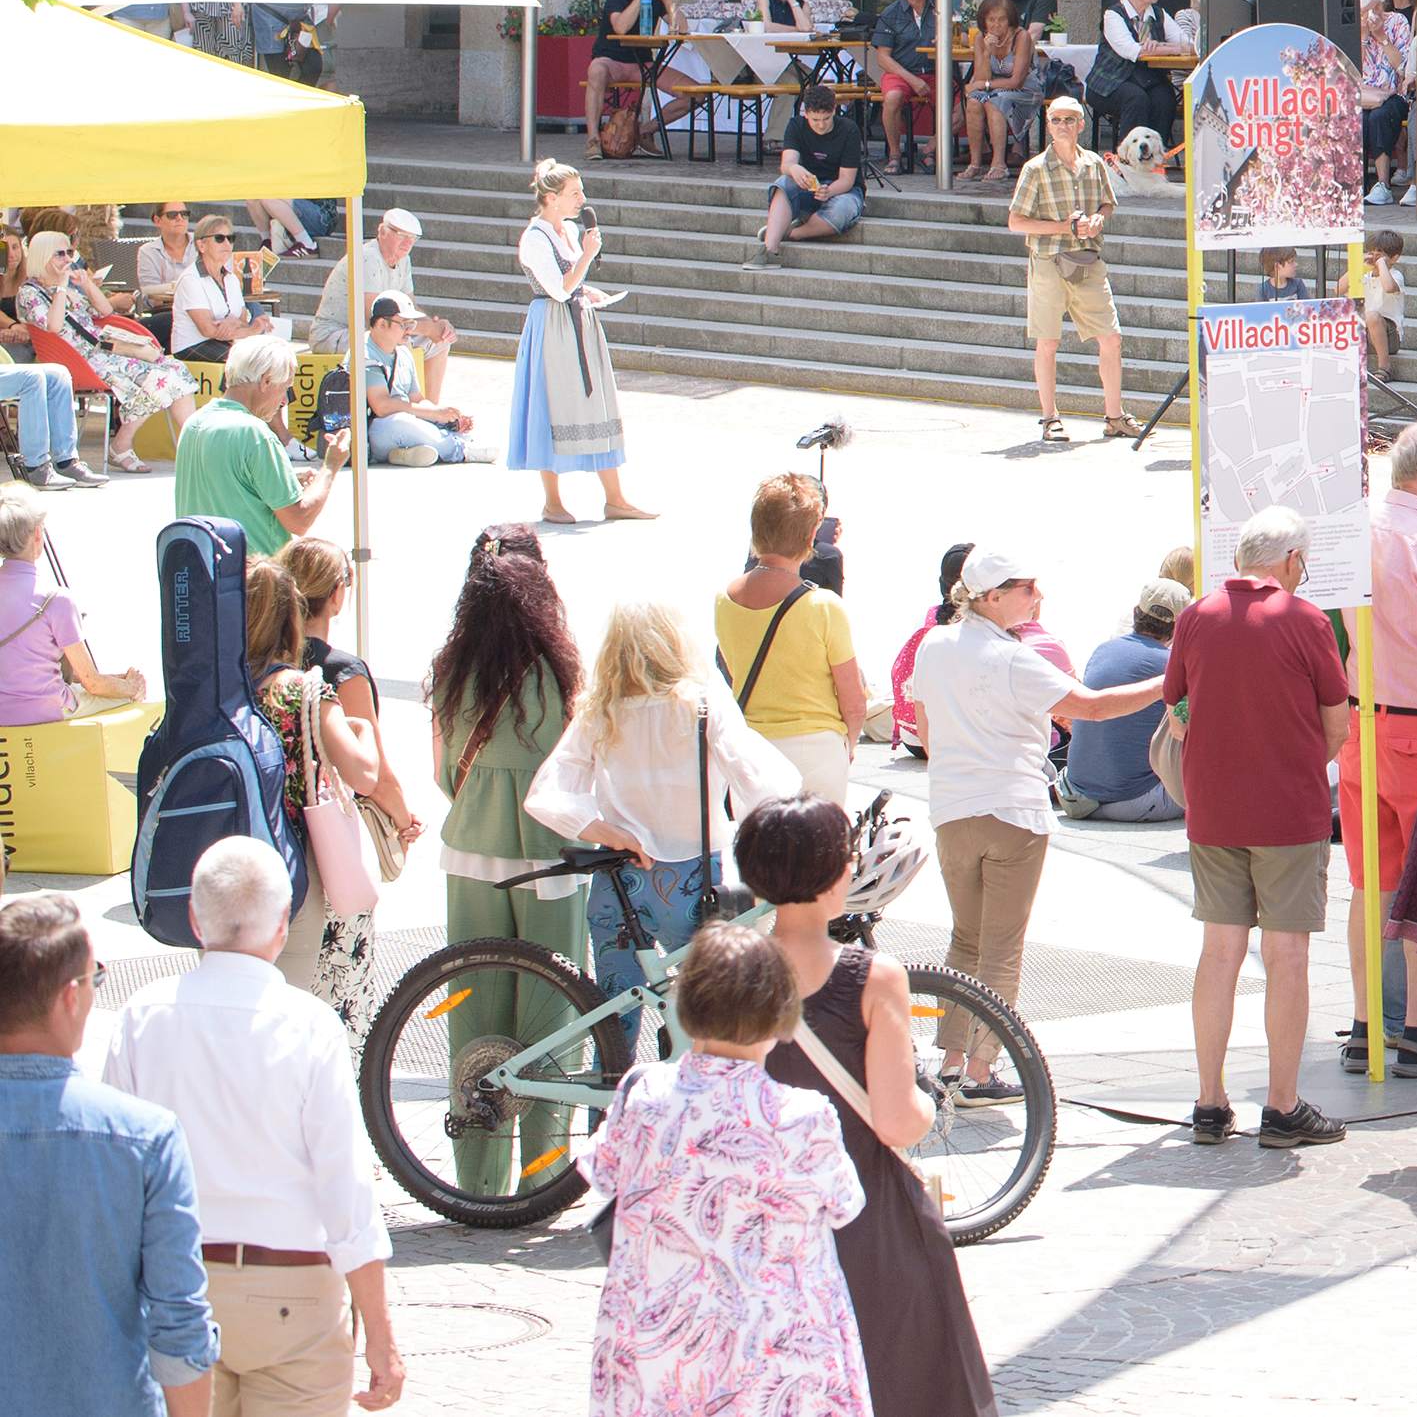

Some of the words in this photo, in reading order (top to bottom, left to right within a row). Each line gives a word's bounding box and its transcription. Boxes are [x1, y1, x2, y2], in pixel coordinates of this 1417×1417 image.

[1226, 77, 1338, 118] Villach
[1230, 112, 1304, 156] singt
[1205, 317, 1289, 350] Villach
[1298, 314, 1360, 351] singt
[175, 572, 191, 643] RITTER
[24, 737, 36, 788] villach.at
[0, 734, 17, 855] villac
[954, 983, 1033, 1060] SCHWALBE
